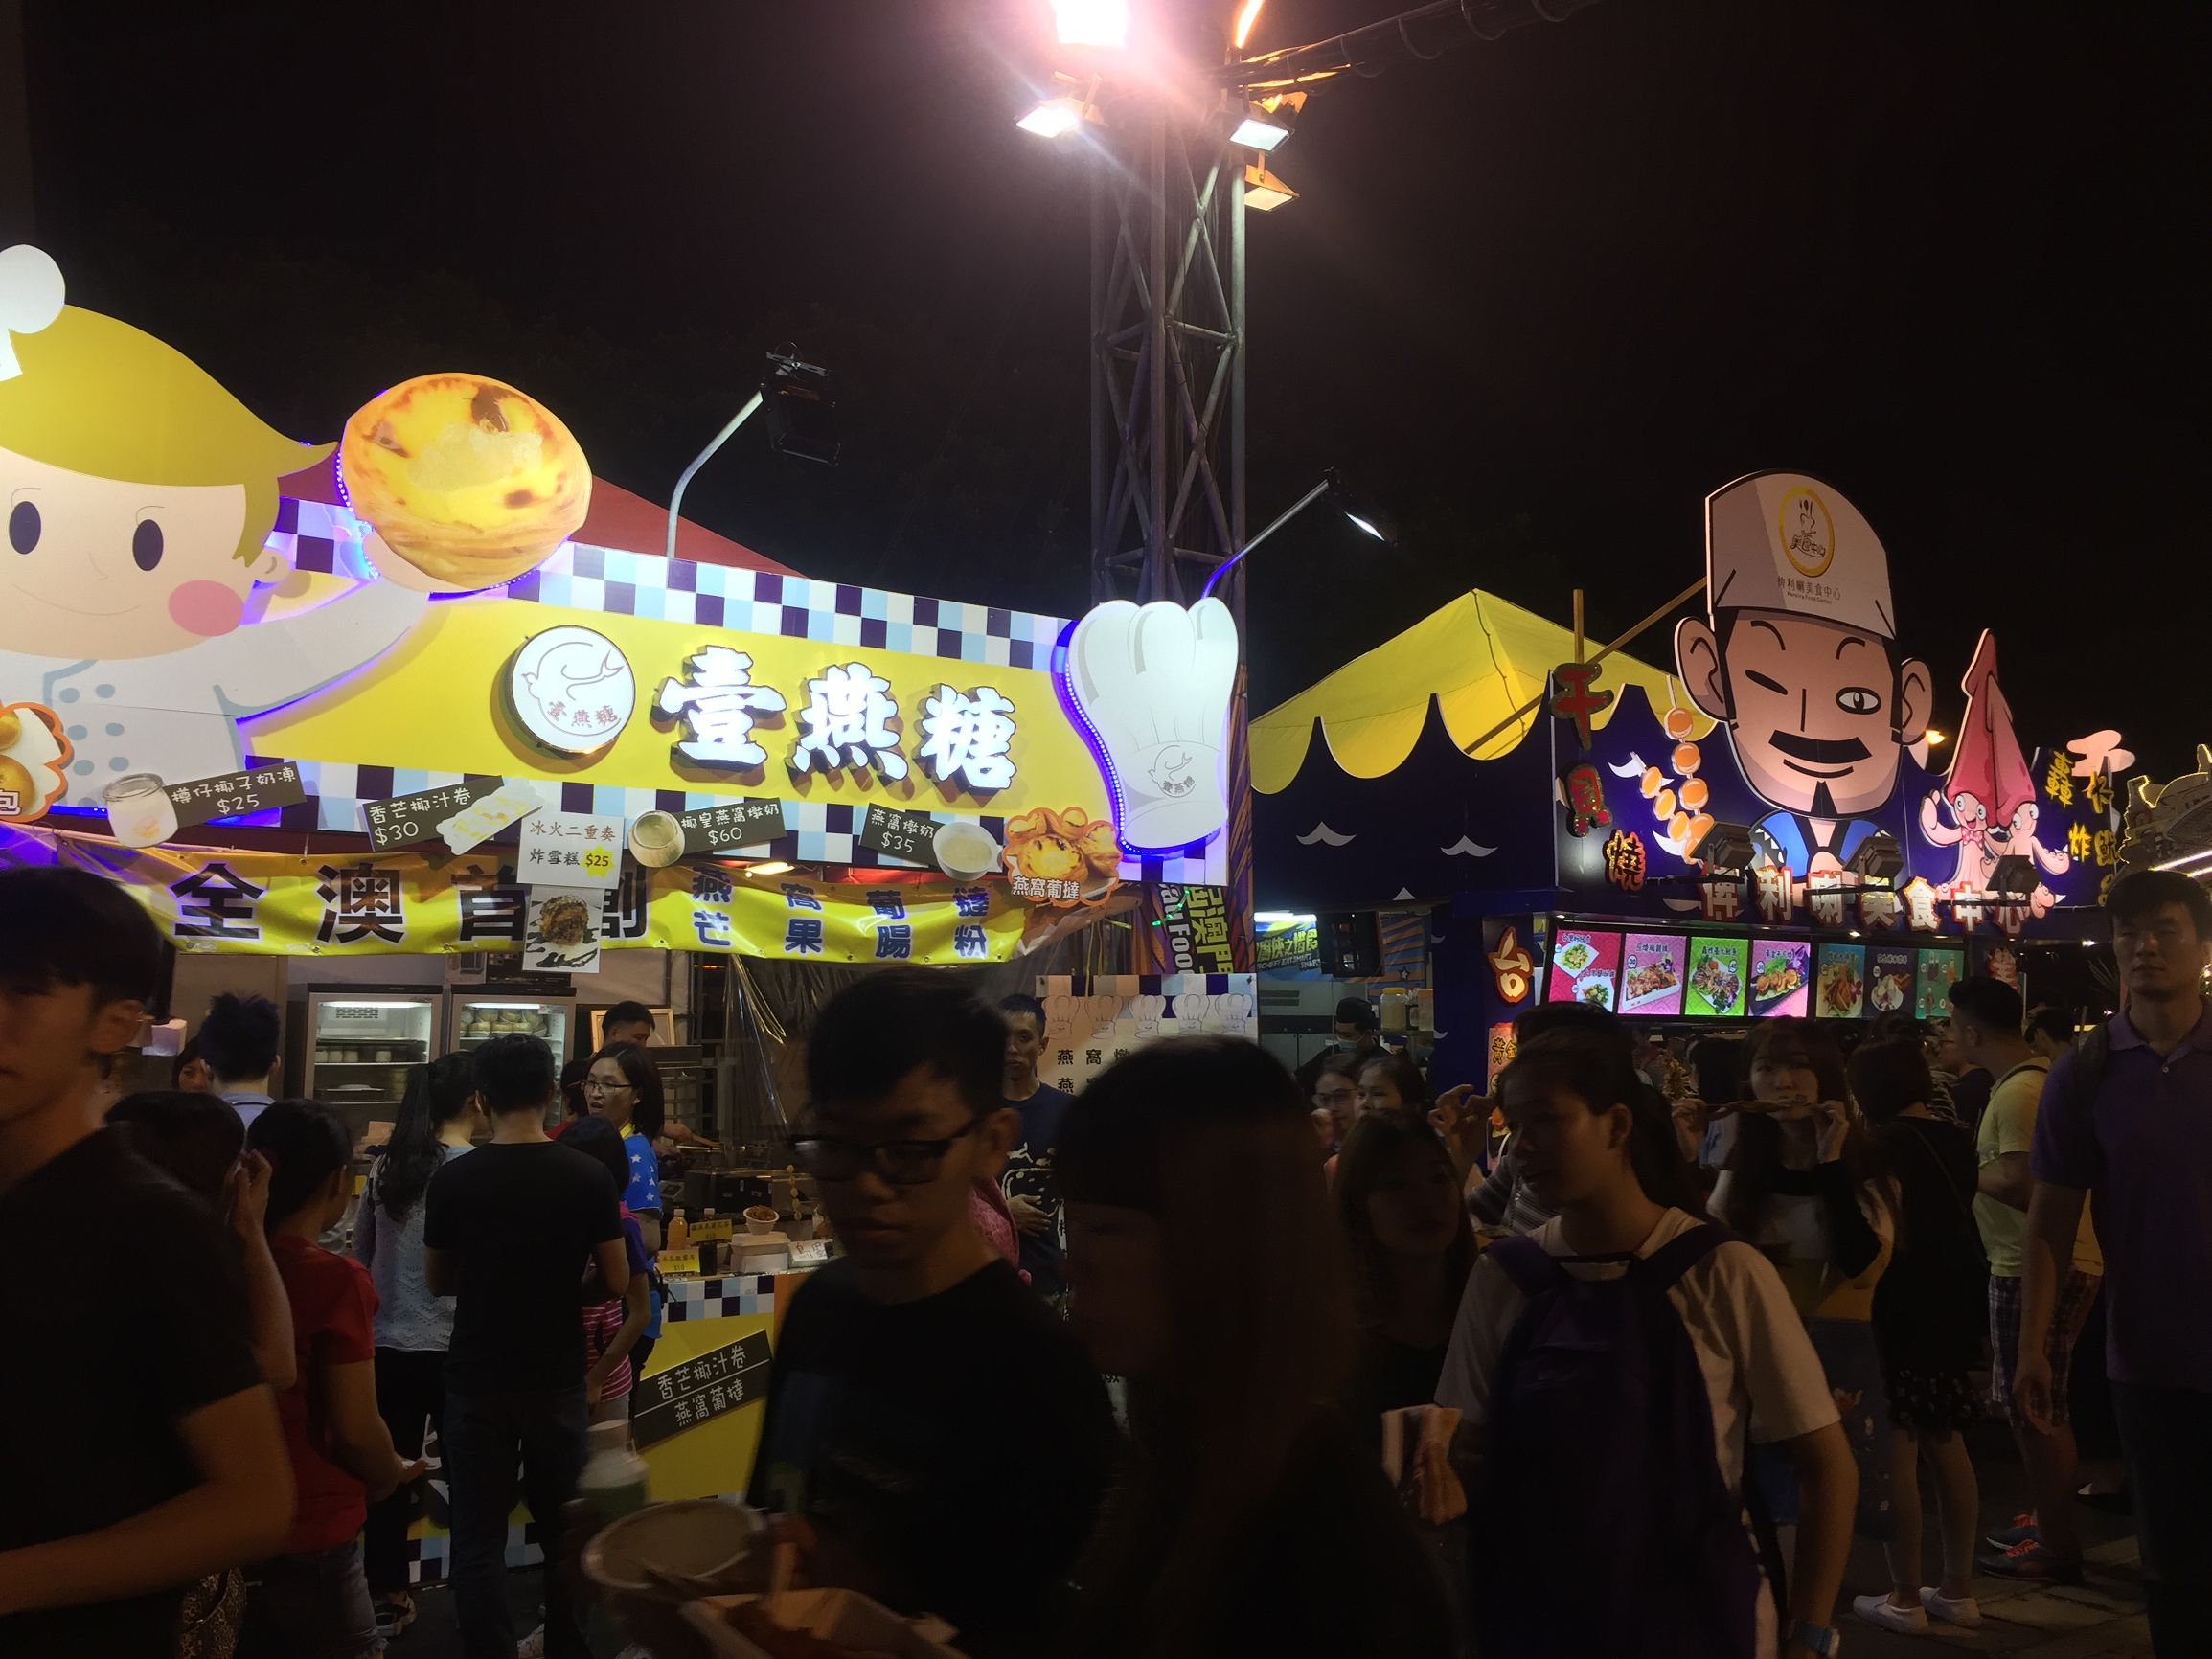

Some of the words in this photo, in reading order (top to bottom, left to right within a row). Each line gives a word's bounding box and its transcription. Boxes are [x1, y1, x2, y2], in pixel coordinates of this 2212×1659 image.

[547, 700, 617, 729] 壹燕糖
[660, 645, 1017, 789] 壹燕糖
[217, 793, 260, 814] $25
[369, 786, 471, 824] 香芒椰汁卷
[375, 821, 419, 846] $30
[529, 820, 615, 842] 冰火二重奏
[708, 827, 742, 846] $60
[881, 831, 916, 853] $35
[529, 848, 580, 866] 炸雪糕
[585, 853, 609, 868] $25
[1011, 875, 1081, 900] 燕窩葡撻
[694, 912, 987, 959] 芒果腸粉
[657, 1345, 747, 1400] 香芒椰汁卷
[674, 1379, 744, 1427] 燕窩葡撻
